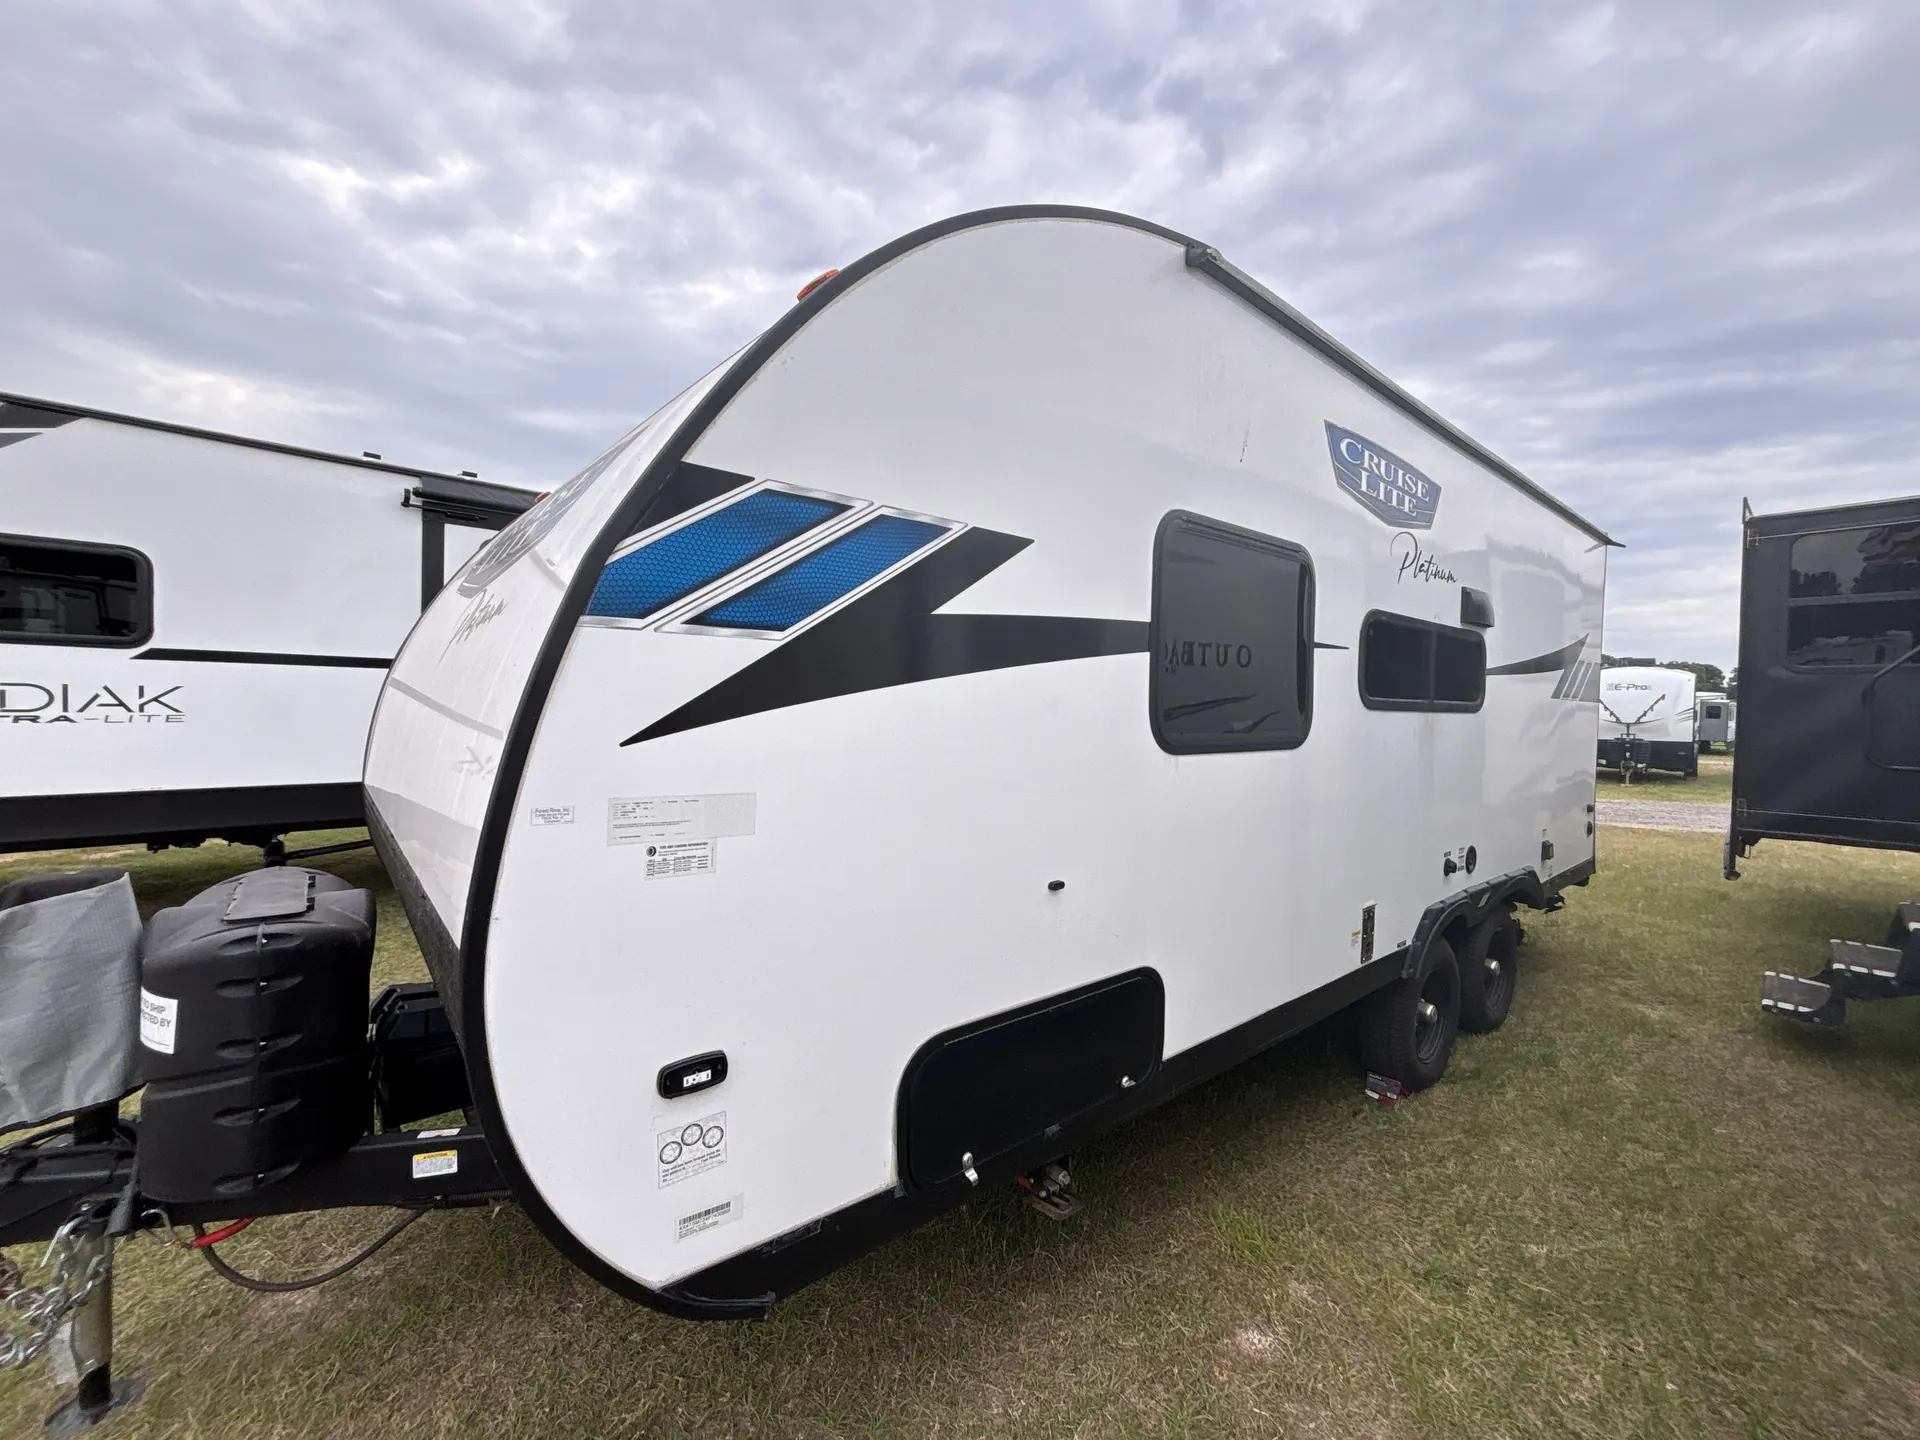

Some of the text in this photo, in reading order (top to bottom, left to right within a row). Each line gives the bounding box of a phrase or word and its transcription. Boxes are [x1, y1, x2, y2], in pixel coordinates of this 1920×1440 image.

[1339, 438, 1429, 501] CRUISE
[1359, 469, 1417, 516] LITE
[1390, 531, 1457, 584] Platinum
[159, 1018, 171, 1028] BY
